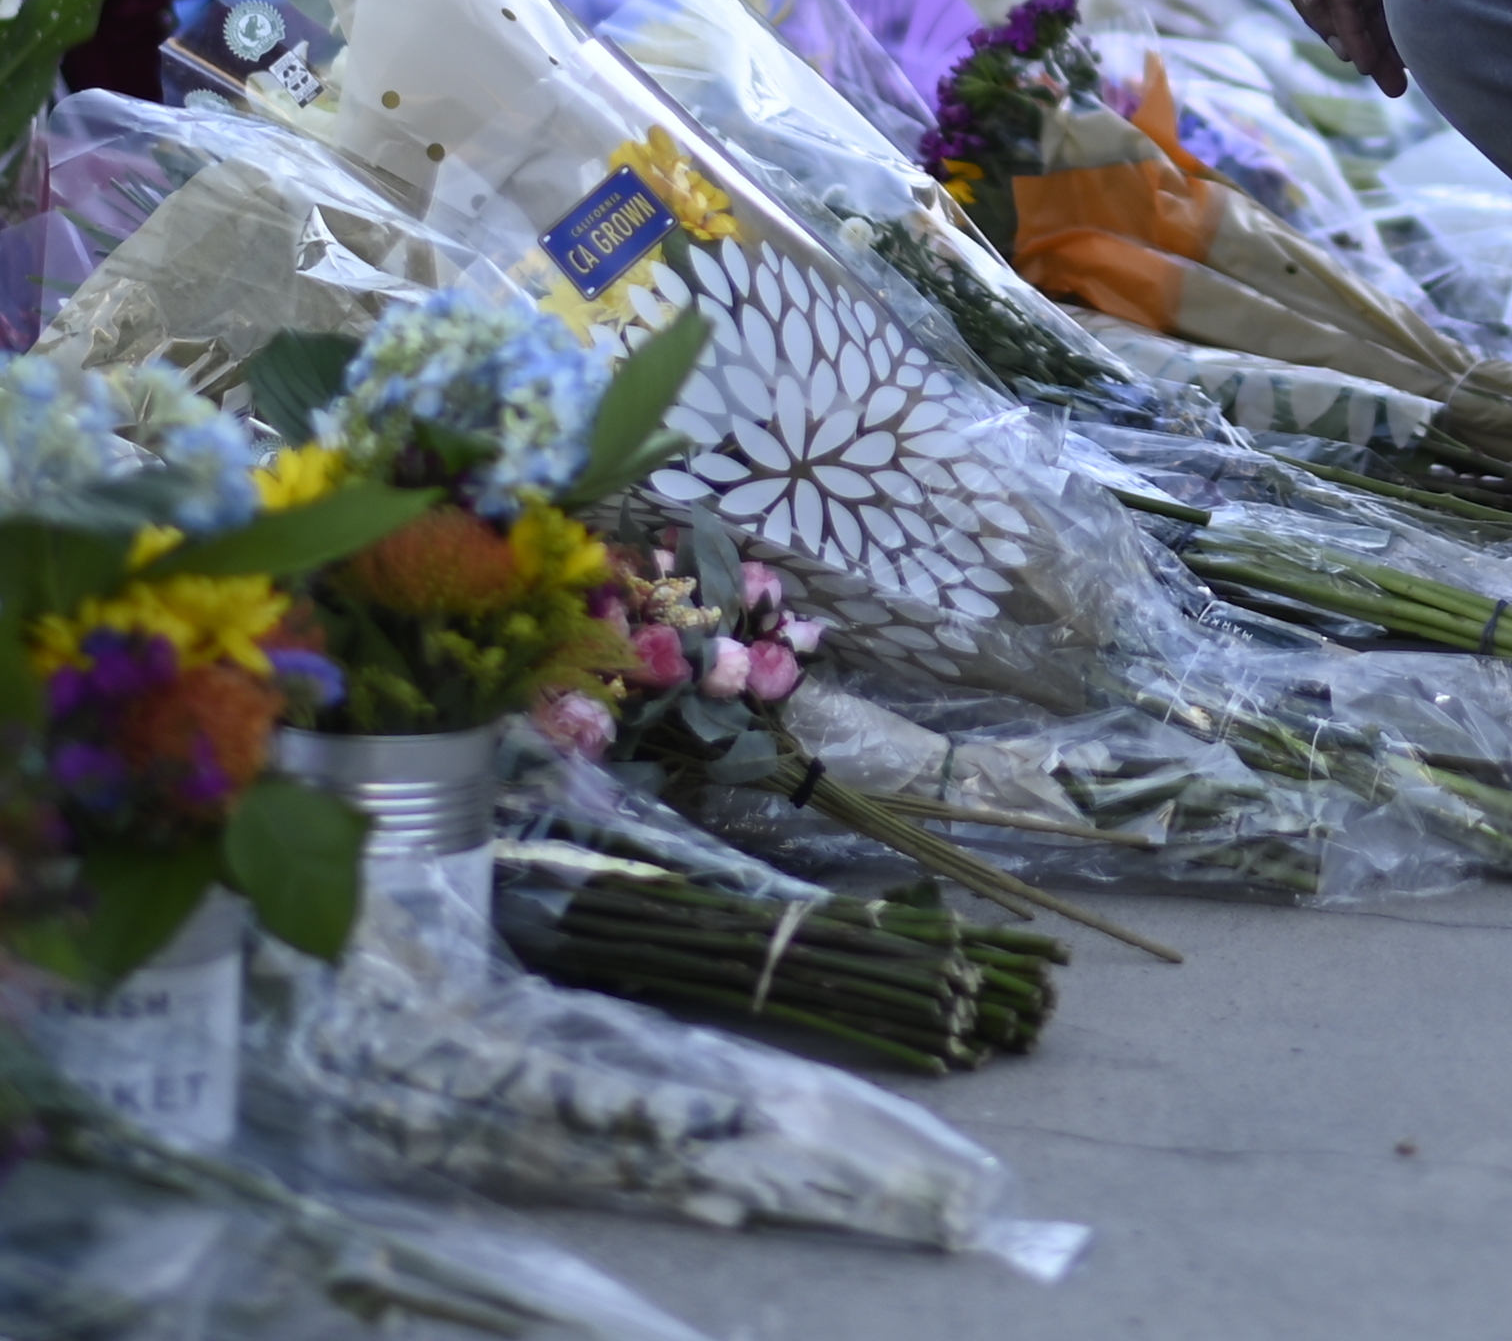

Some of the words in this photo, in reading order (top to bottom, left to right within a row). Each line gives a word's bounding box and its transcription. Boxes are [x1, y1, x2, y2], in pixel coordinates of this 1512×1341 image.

[568, 244, 600, 274] CA
[590, 192, 657, 255] GROWN
[571, 192, 623, 237] CALIFORNIA
